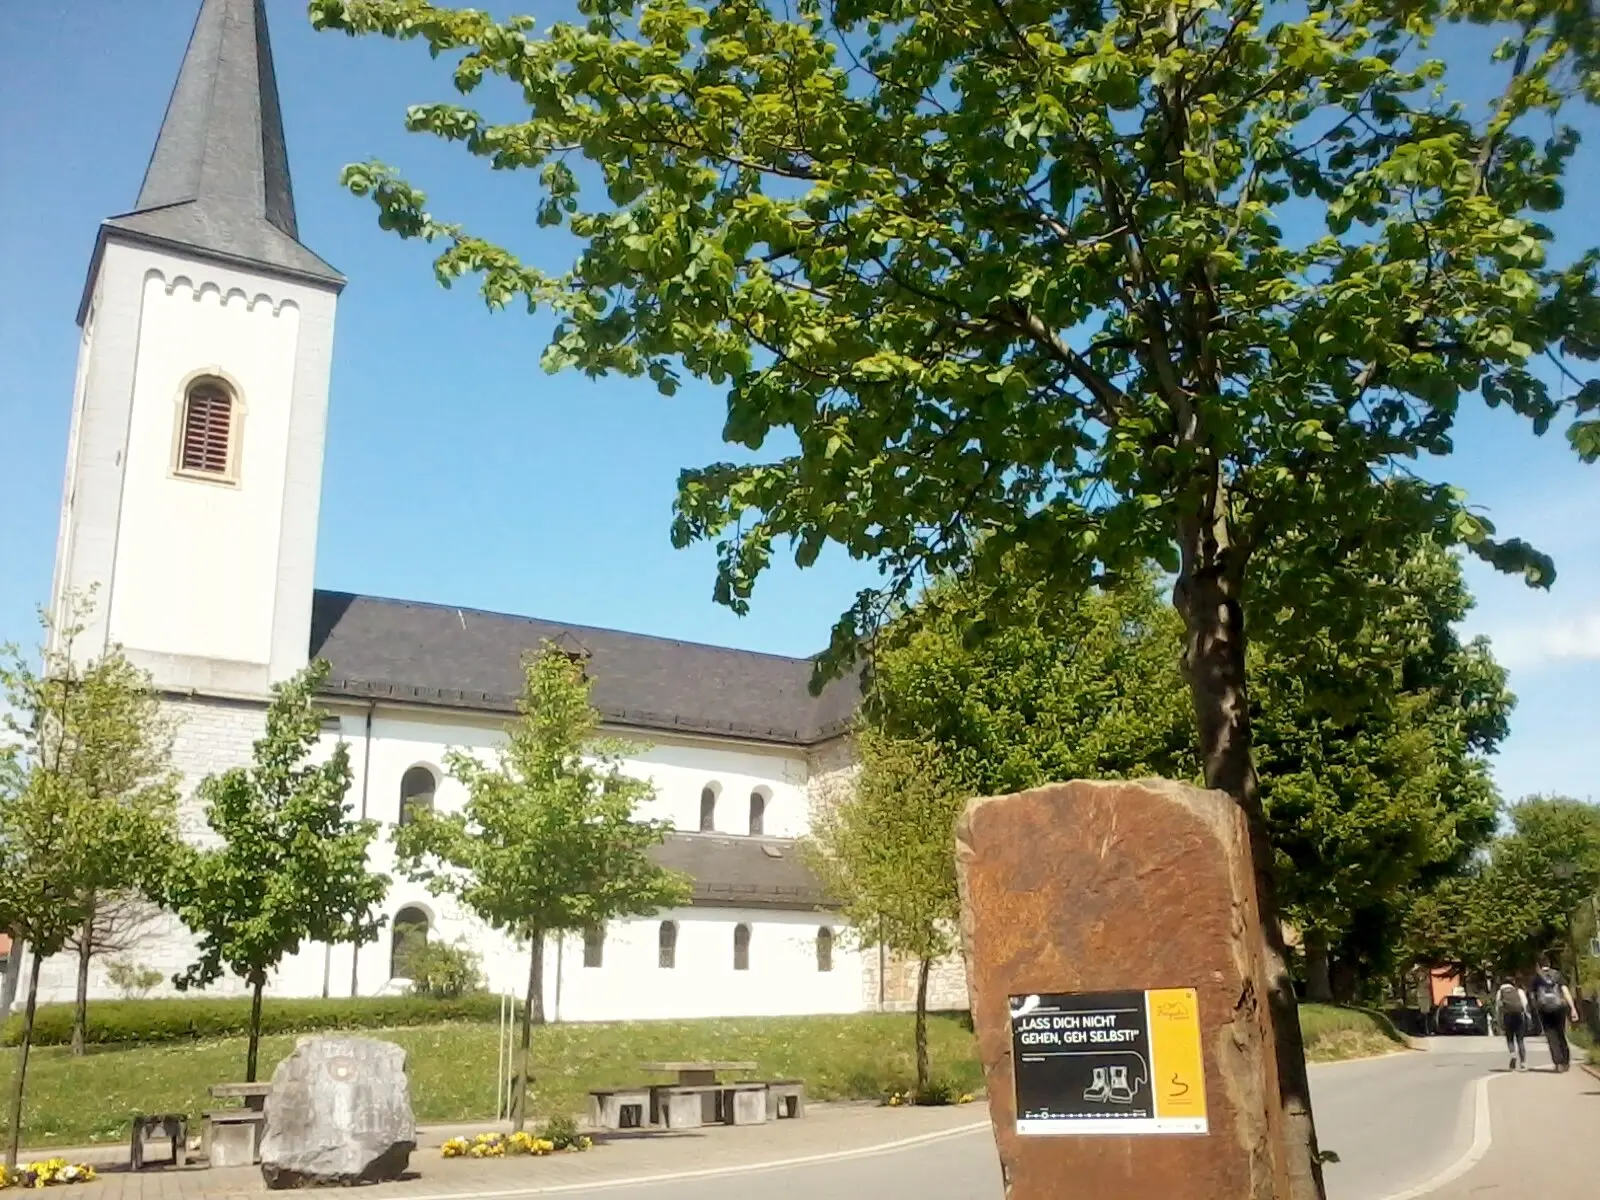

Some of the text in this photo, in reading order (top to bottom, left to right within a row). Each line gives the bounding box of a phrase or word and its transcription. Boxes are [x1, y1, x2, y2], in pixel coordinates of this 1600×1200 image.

[1053, 1017, 1080, 1029] DICH
[1083, 1015, 1116, 1028] NICHT
[1021, 1032, 1061, 1045] GEHEN,
[1063, 1031, 1087, 1043] GEH
